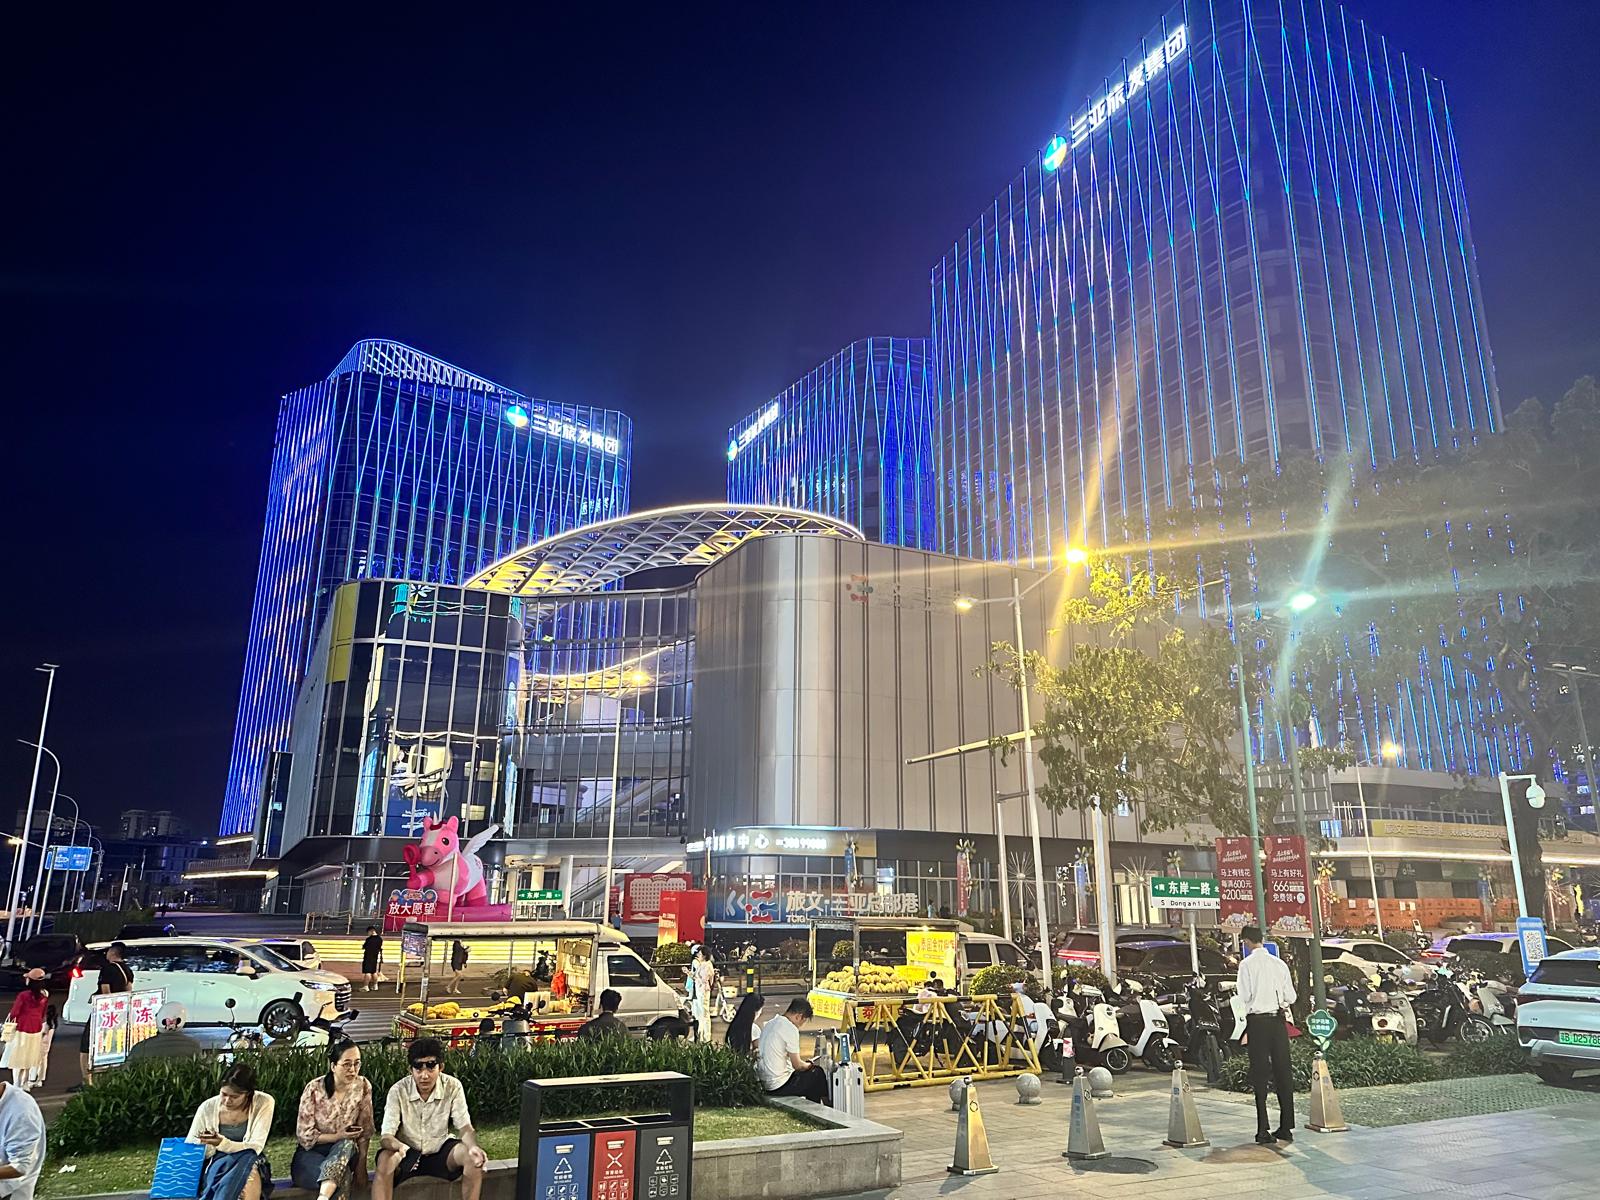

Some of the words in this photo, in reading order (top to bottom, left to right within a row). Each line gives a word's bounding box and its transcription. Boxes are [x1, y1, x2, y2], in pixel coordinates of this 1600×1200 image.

[1071, 24, 1188, 149] 三亚旅发集团
[1220, 868, 1252, 877] 马上有钱花
[1270, 868, 1304, 878] 马上有好礼
[1168, 881, 1211, 895] 东岸一路
[1272, 893, 1294, 903] 免费领
[388, 902, 435, 915] 放大愿望
[102, 1012, 119, 1027] 冰
[135, 1008, 153, 1022] 冻
